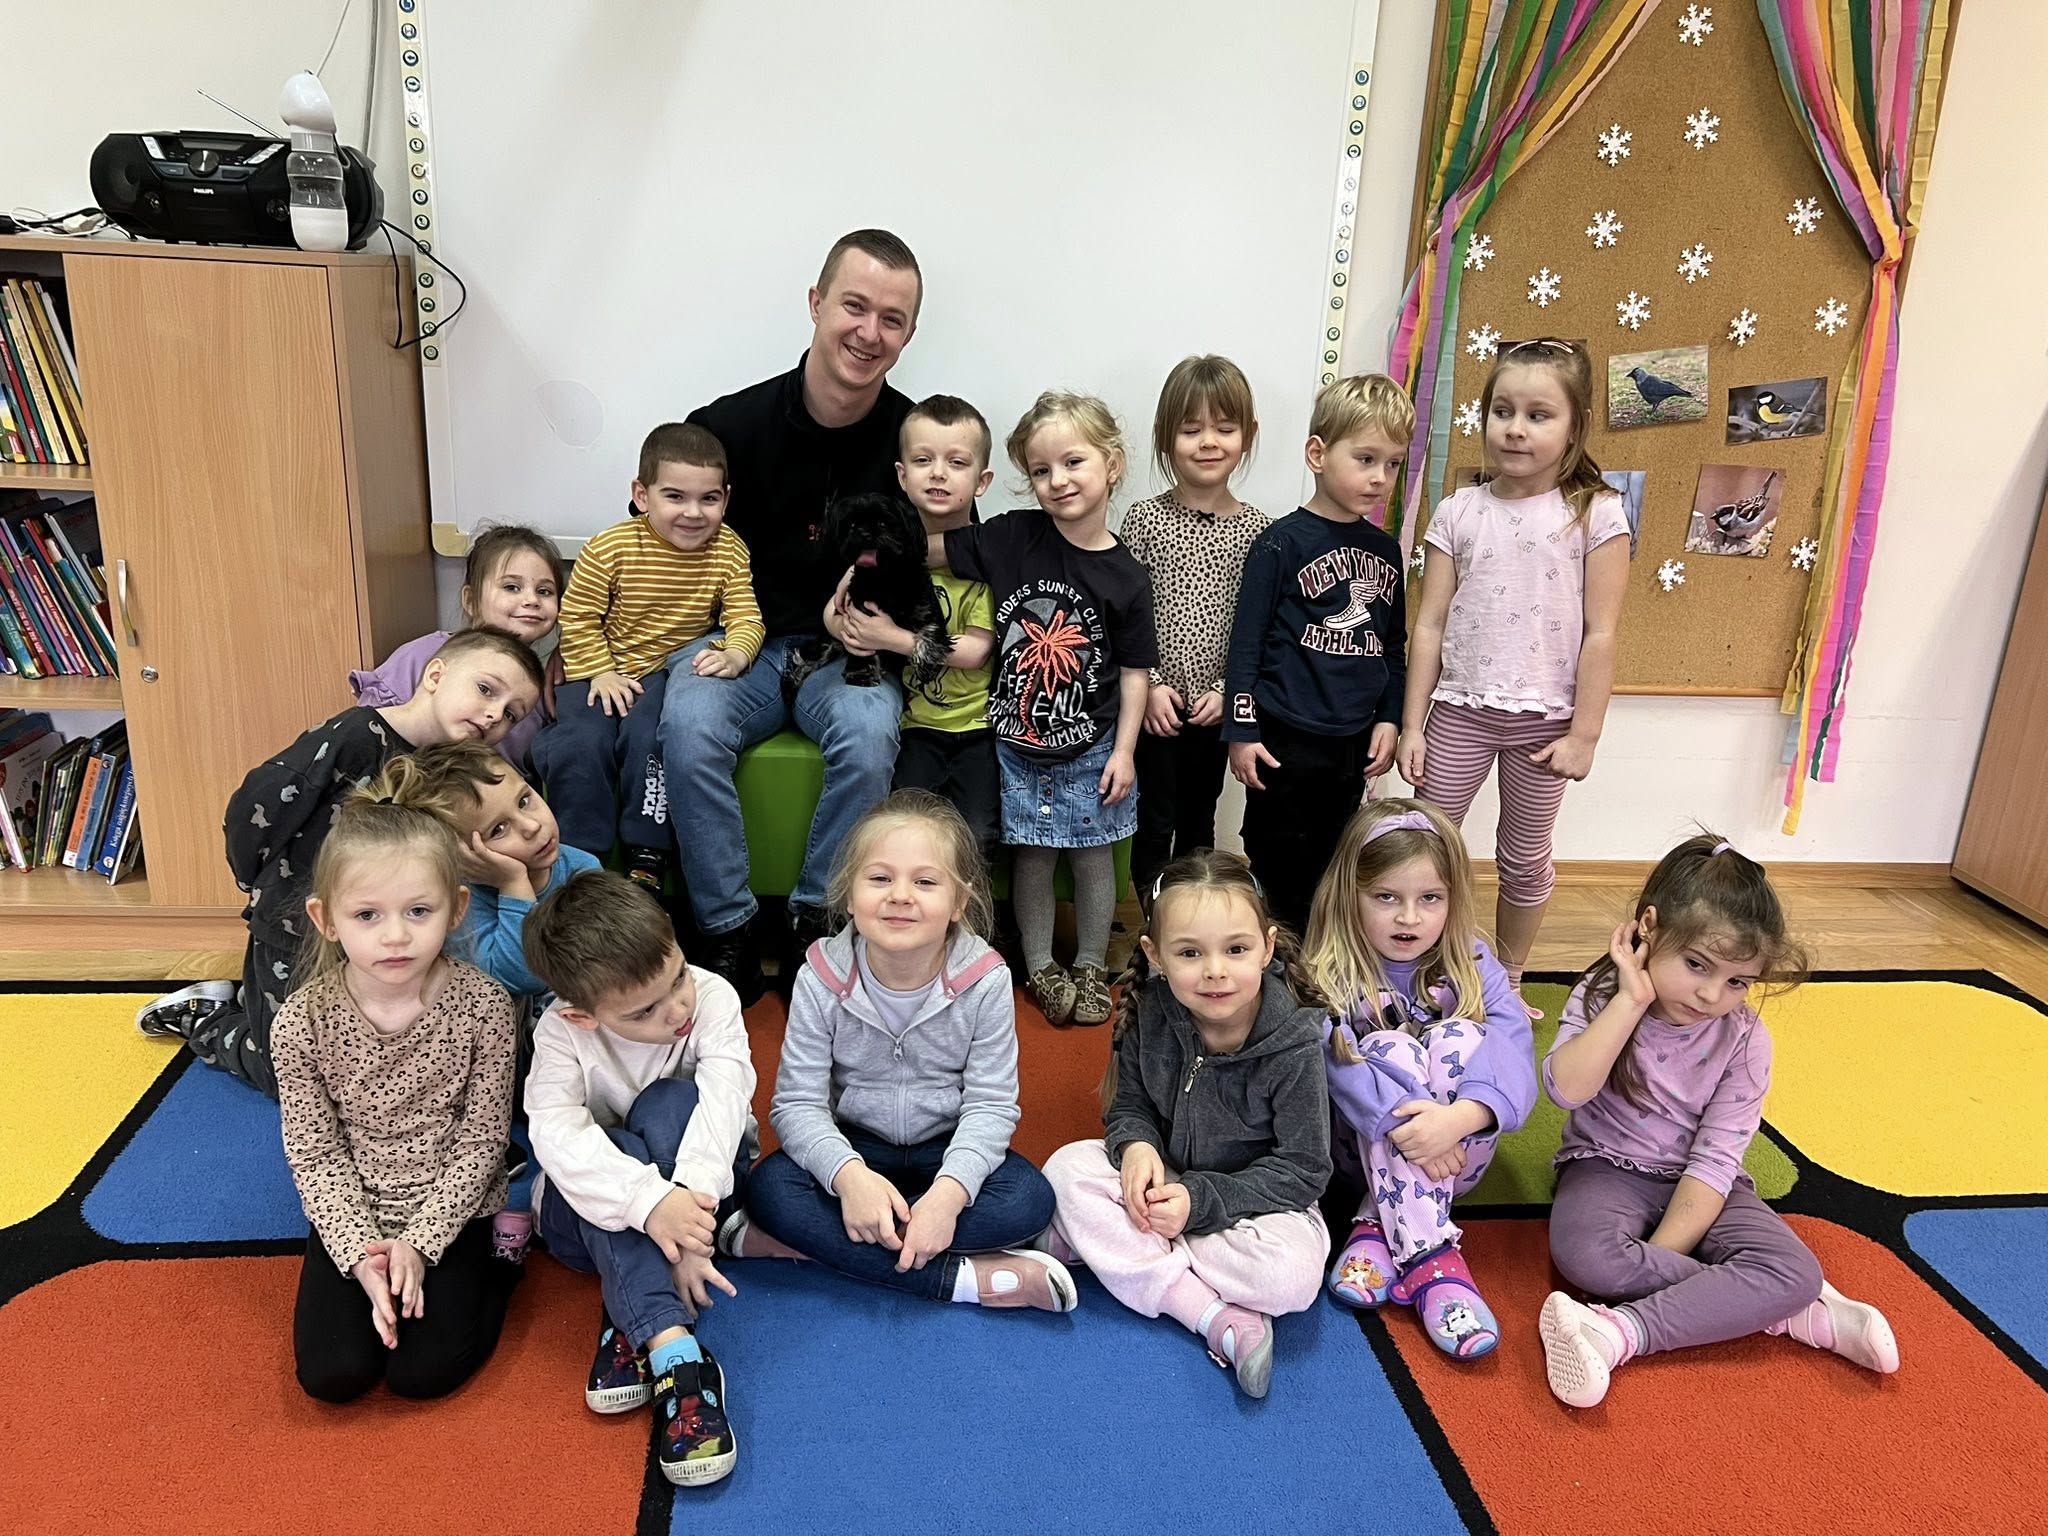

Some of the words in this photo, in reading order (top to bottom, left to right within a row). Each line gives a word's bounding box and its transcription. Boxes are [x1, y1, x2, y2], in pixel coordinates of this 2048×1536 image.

[997, 584, 1031, 624] RIDERS
[1083, 607, 1103, 641] CLUB
[1301, 624, 1363, 656] ATHL.
[1031, 681, 1083, 718] END
[1234, 693, 1257, 722] 2
[1040, 720, 1097, 748] SUMMER
[641, 778, 657, 816] DUCK
